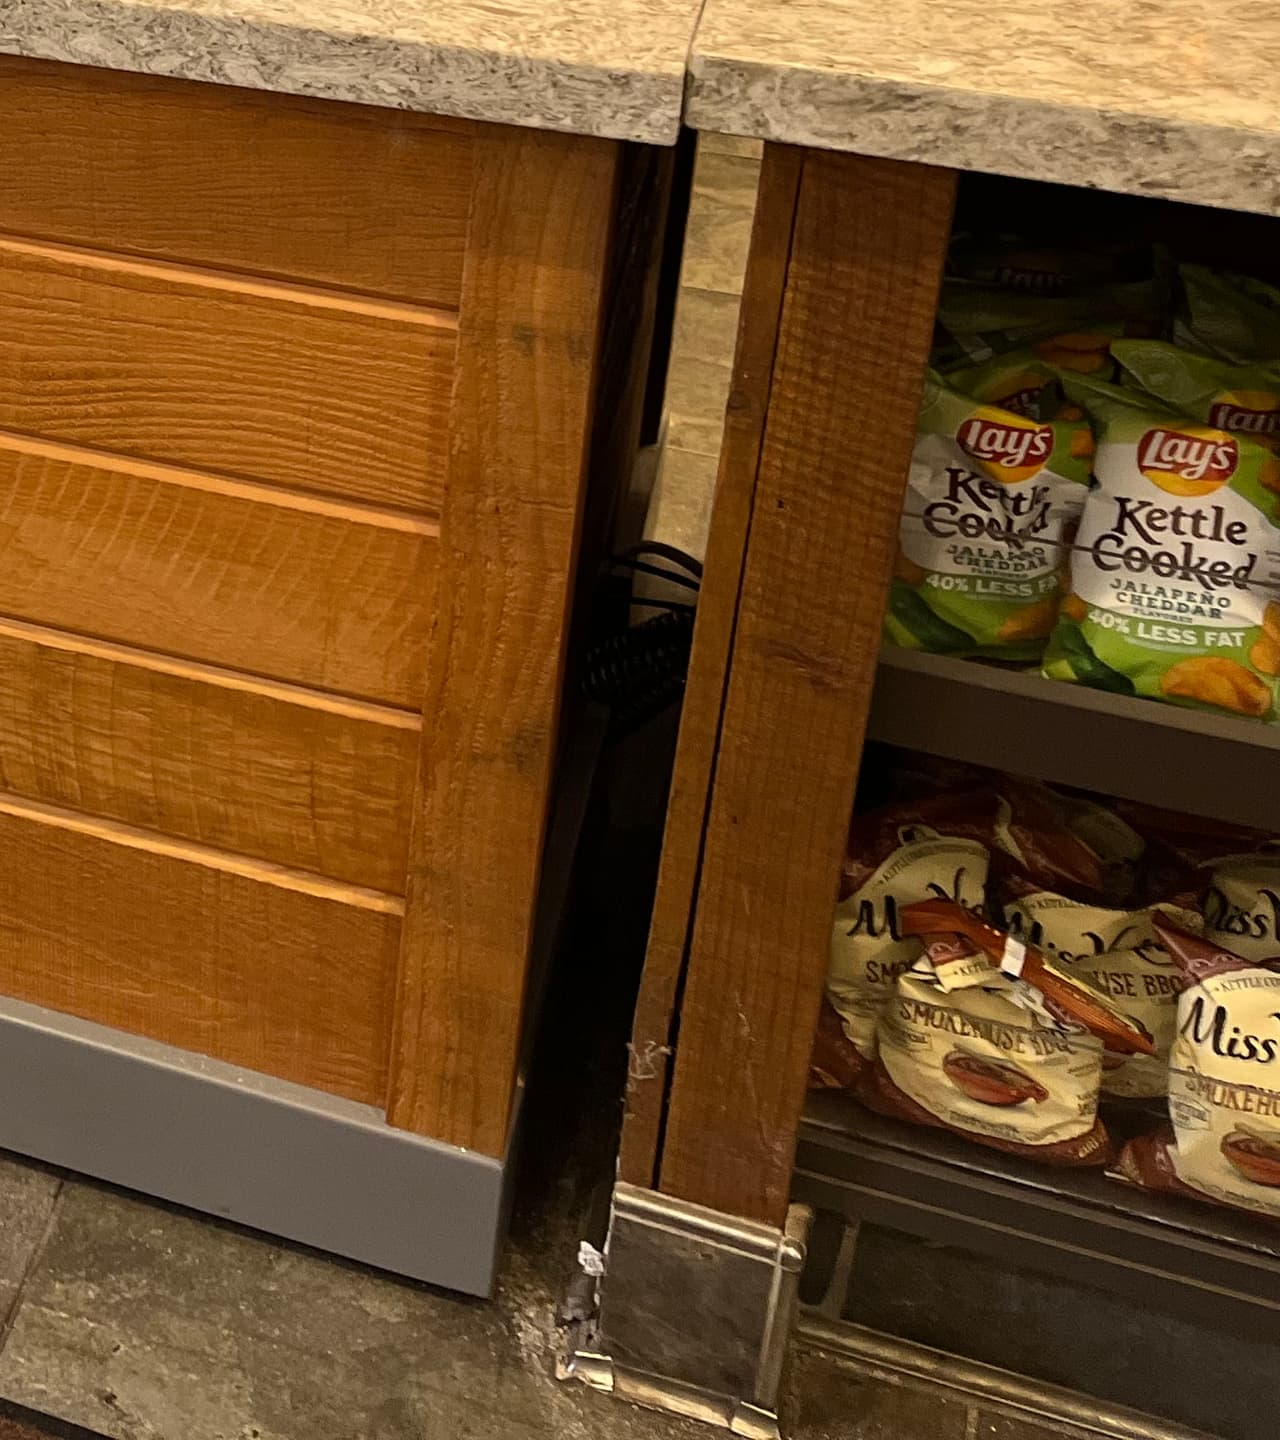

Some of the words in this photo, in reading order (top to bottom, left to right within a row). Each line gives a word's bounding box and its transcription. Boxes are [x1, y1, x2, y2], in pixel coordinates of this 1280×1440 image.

[966, 420, 1052, 466] Lay's
[1145, 432, 1236, 480] Lay's
[1111, 496, 1248, 545] Kettle
[926, 574, 968, 591] 40%
[976, 580, 1032, 596] LESS
[1092, 534, 1257, 590] Cooked
[1110, 579, 1231, 607] JALAPEÑO
[1116, 592, 1222, 619] CHEDDAR
[1088, 611, 1130, 633] 40%
[1138, 623, 1197, 644] LESS
[1205, 632, 1245, 647] FAT
[1180, 997, 1277, 1063] Miss
